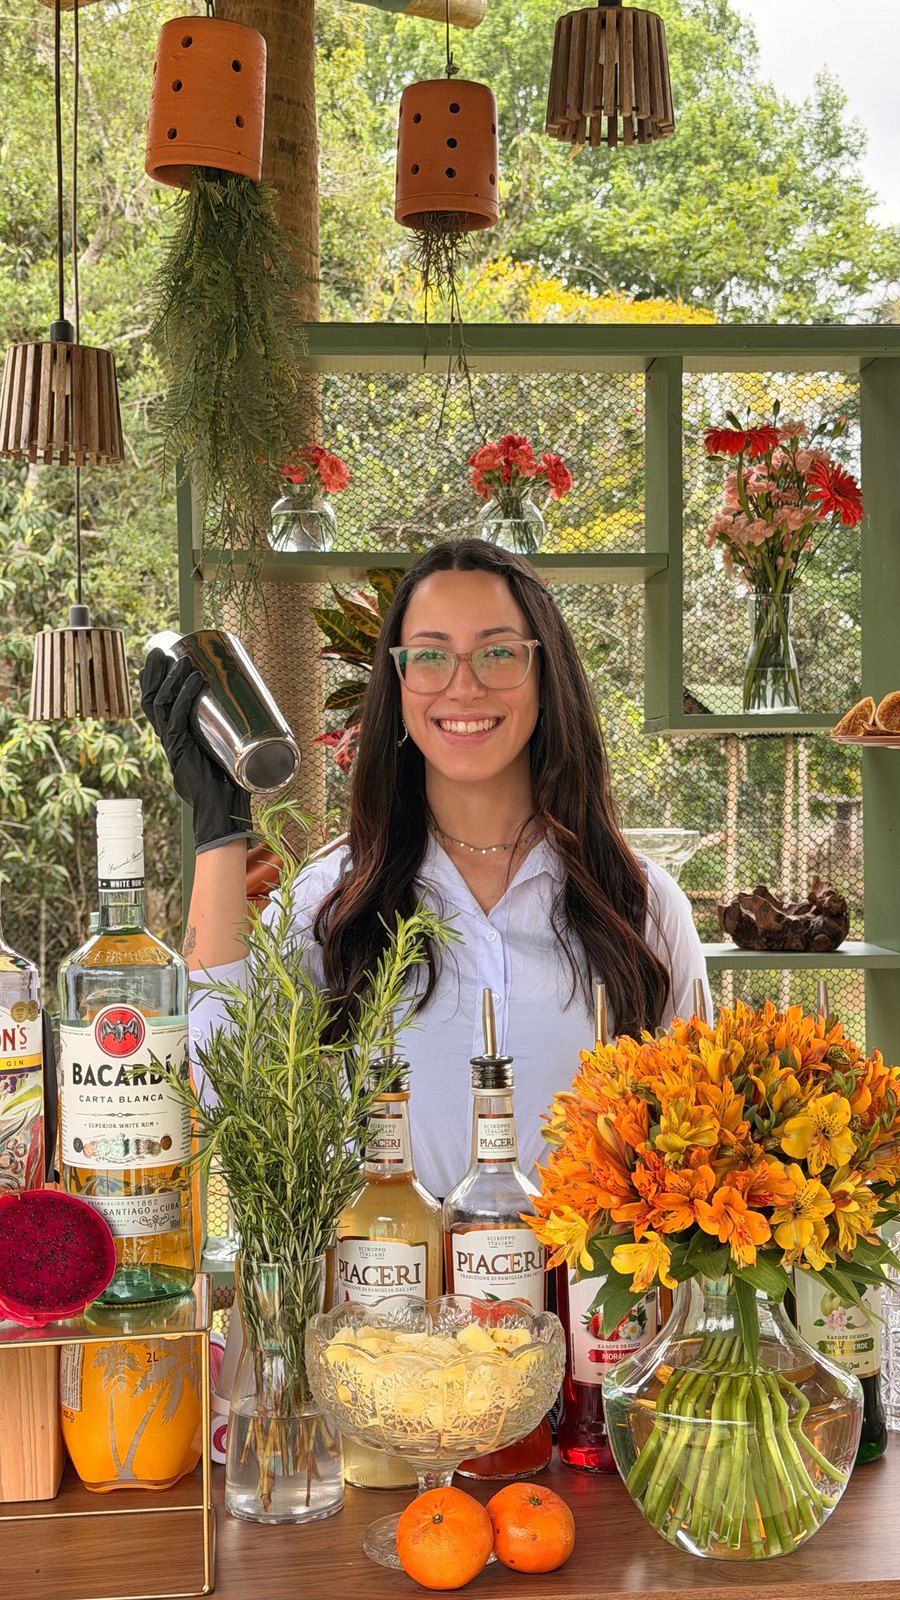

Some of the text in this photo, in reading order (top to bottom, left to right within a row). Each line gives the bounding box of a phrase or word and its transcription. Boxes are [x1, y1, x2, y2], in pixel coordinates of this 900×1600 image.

[0, 1024, 27, 1051] N'S
[79, 1093, 164, 1103] CARTA BLANCA
[480, 1137, 514, 1148] PIACERI
[137, 1199, 158, 1207] 1862
[103, 1207, 150, 1216] SANTIAGO
[160, 1202, 180, 1212] CUBA
[456, 1247, 543, 1275] PIACERI
[339, 1258, 421, 1287] PIACERI
[460, 1273, 490, 1281] TRADIZIONE
[146, 1352, 159, 1363] 2L
